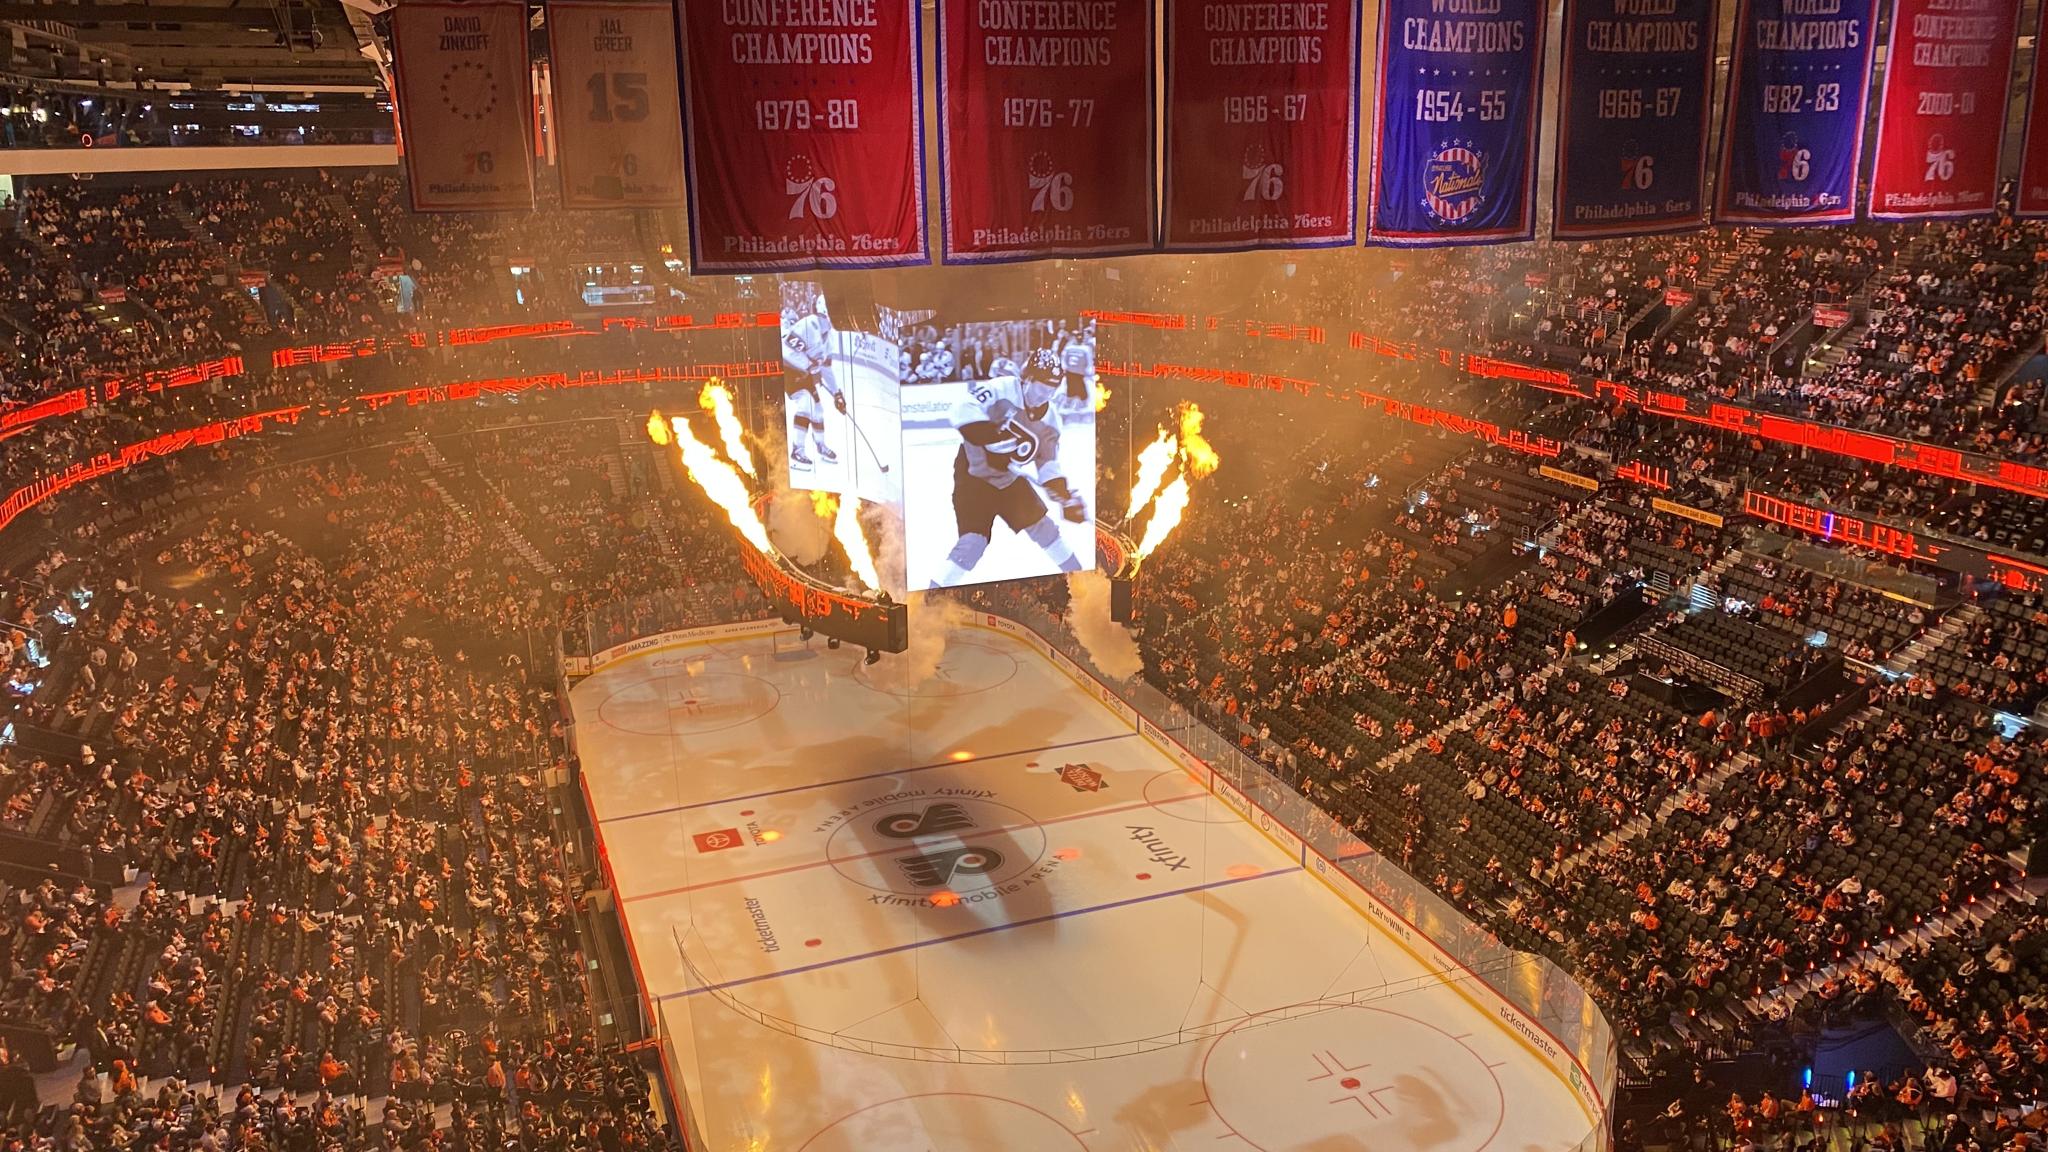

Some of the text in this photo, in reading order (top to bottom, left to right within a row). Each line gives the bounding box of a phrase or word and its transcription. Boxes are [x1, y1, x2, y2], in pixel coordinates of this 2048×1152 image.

[444, 16, 481, 33] DAVID
[601, 18, 623, 34] HAL
[722, 0, 877, 27] CONFERENCE
[978, 0, 1117, 31] CONFERENCE
[1204, 2, 1328, 31] CONFERENCE
[1913, 14, 1999, 39] CONFERENCE
[439, 34, 490, 51] ZINKOFF
[593, 36, 633, 51] GREER
[731, 31, 873, 65] CHAMPIONS
[1404, 17, 1524, 53] CHAMPIONS
[1587, 20, 1698, 52] CHAMPIONS
[1757, 19, 1860, 50] CHAMPIONS
[985, 36, 1112, 67] CHAMPIONS
[1209, 35, 1322, 66] CHAMPIONS
[1913, 43, 1990, 67] CHAMPIONS
[587, 72, 649, 123] 15
[463, 152, 494, 174] 76
[609, 153, 638, 176] 76
[1620, 155, 1654, 190] 76
[1779, 149, 1811, 181] 76
[1924, 150, 1955, 181] 76
[428, 182, 500, 195] Philadelphia
[1028, 171, 1074, 212] 76
[1242, 163, 1284, 201] 76
[785, 176, 838, 220] 76
[1575, 201, 1656, 220] Philadelphia
[1736, 192, 1810, 210] Philadelphia
[1885, 191, 1955, 208] Philadelphia
[972, 223, 1131, 247] Philadelphia 76ers
[1189, 212, 1332, 234] Philadelphia 76ers
[723, 232, 900, 257] Philadelphia 76ers
[997, 620, 1016, 631] TOYOTA
[813, 787, 997, 833] xfinity mobile ARENA
[746, 821, 767, 847] TOYOTA
[1125, 825, 1191, 872] xfinity
[867, 853, 1065, 909] xfinity mobile ARENA
[743, 897, 781, 953] ticketmaster
[1368, 901, 1384, 920] PLAY
[1389, 918, 1404, 937] WIN!
[1500, 1006, 1557, 1059] ticketmaster
